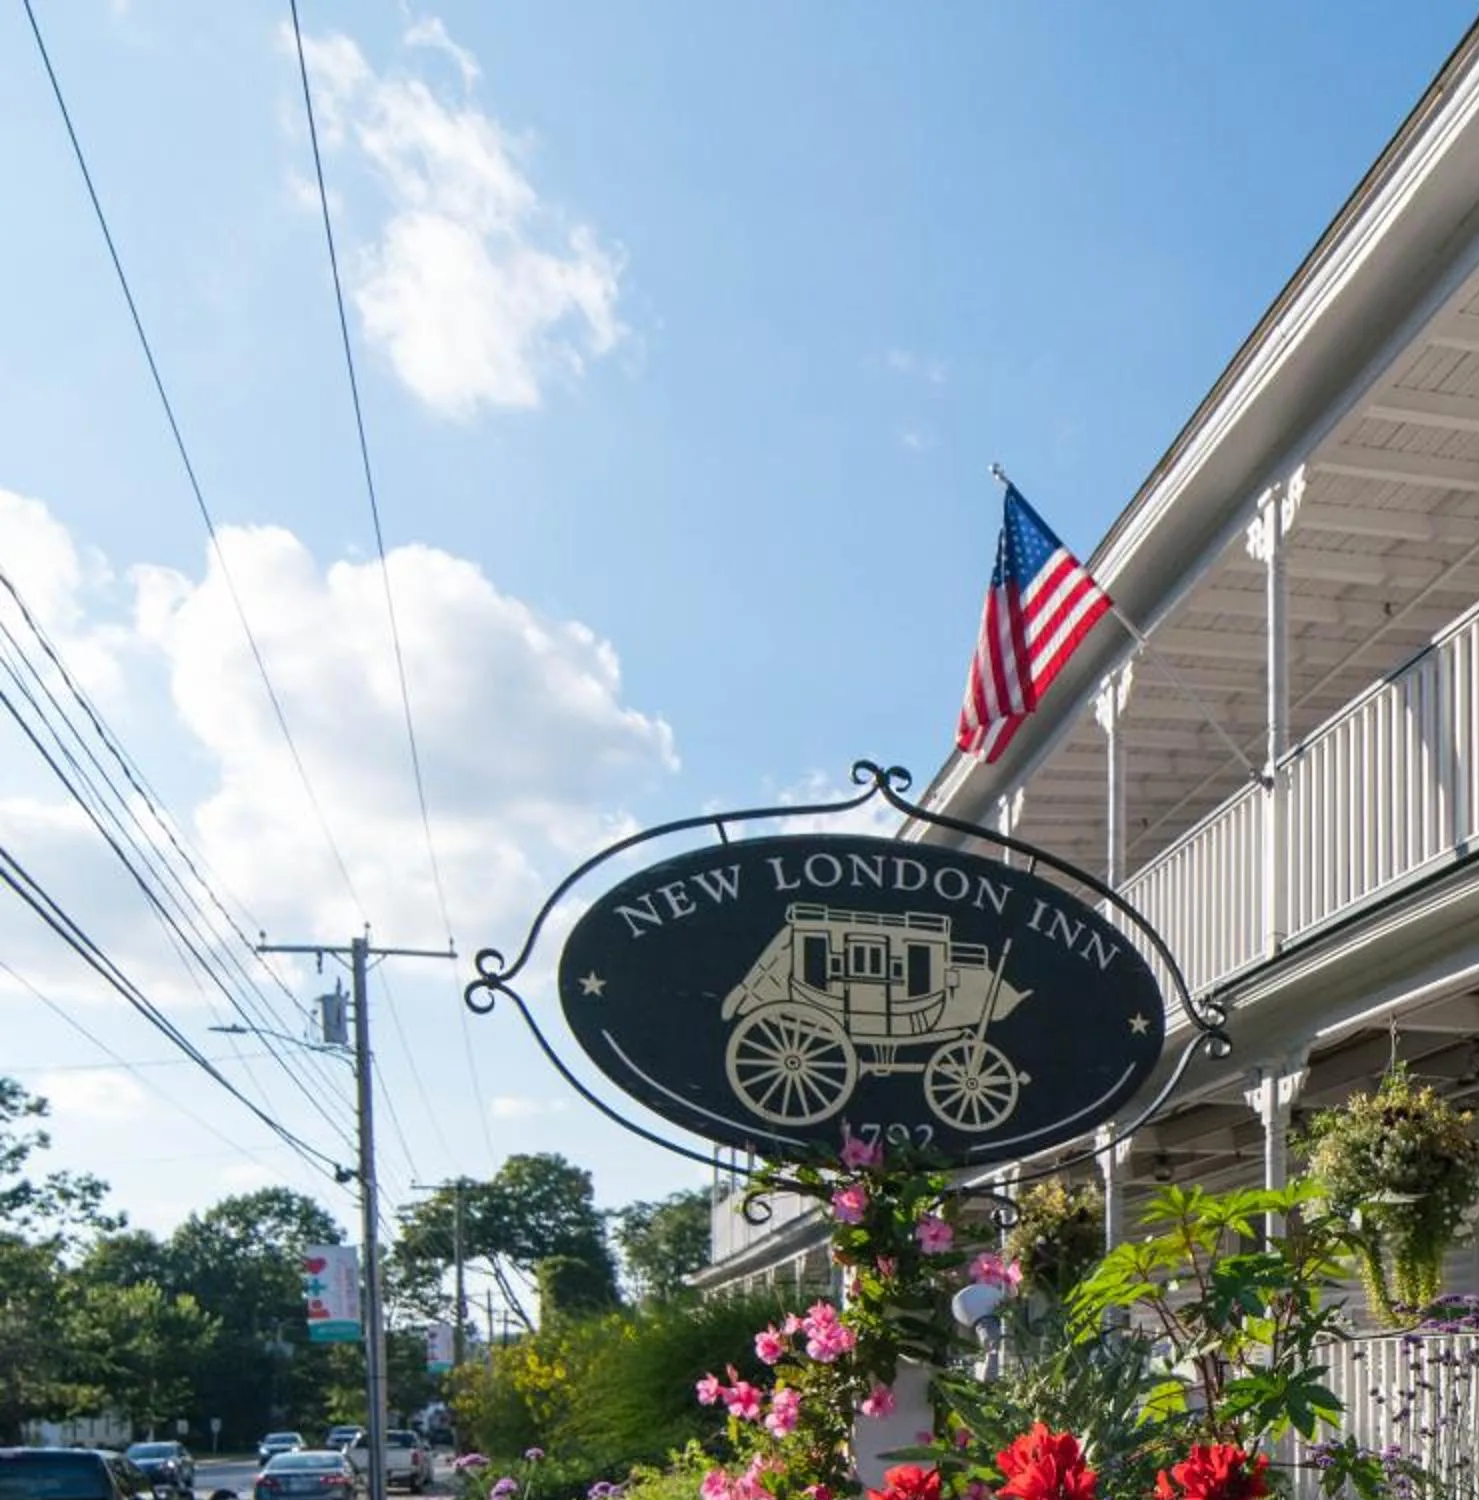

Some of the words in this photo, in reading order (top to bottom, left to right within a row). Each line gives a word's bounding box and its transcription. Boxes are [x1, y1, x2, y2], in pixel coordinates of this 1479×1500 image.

[613, 864, 741, 938] NEW
[767, 853, 1013, 915] LONDON
[1026, 899, 1120, 970] INN
